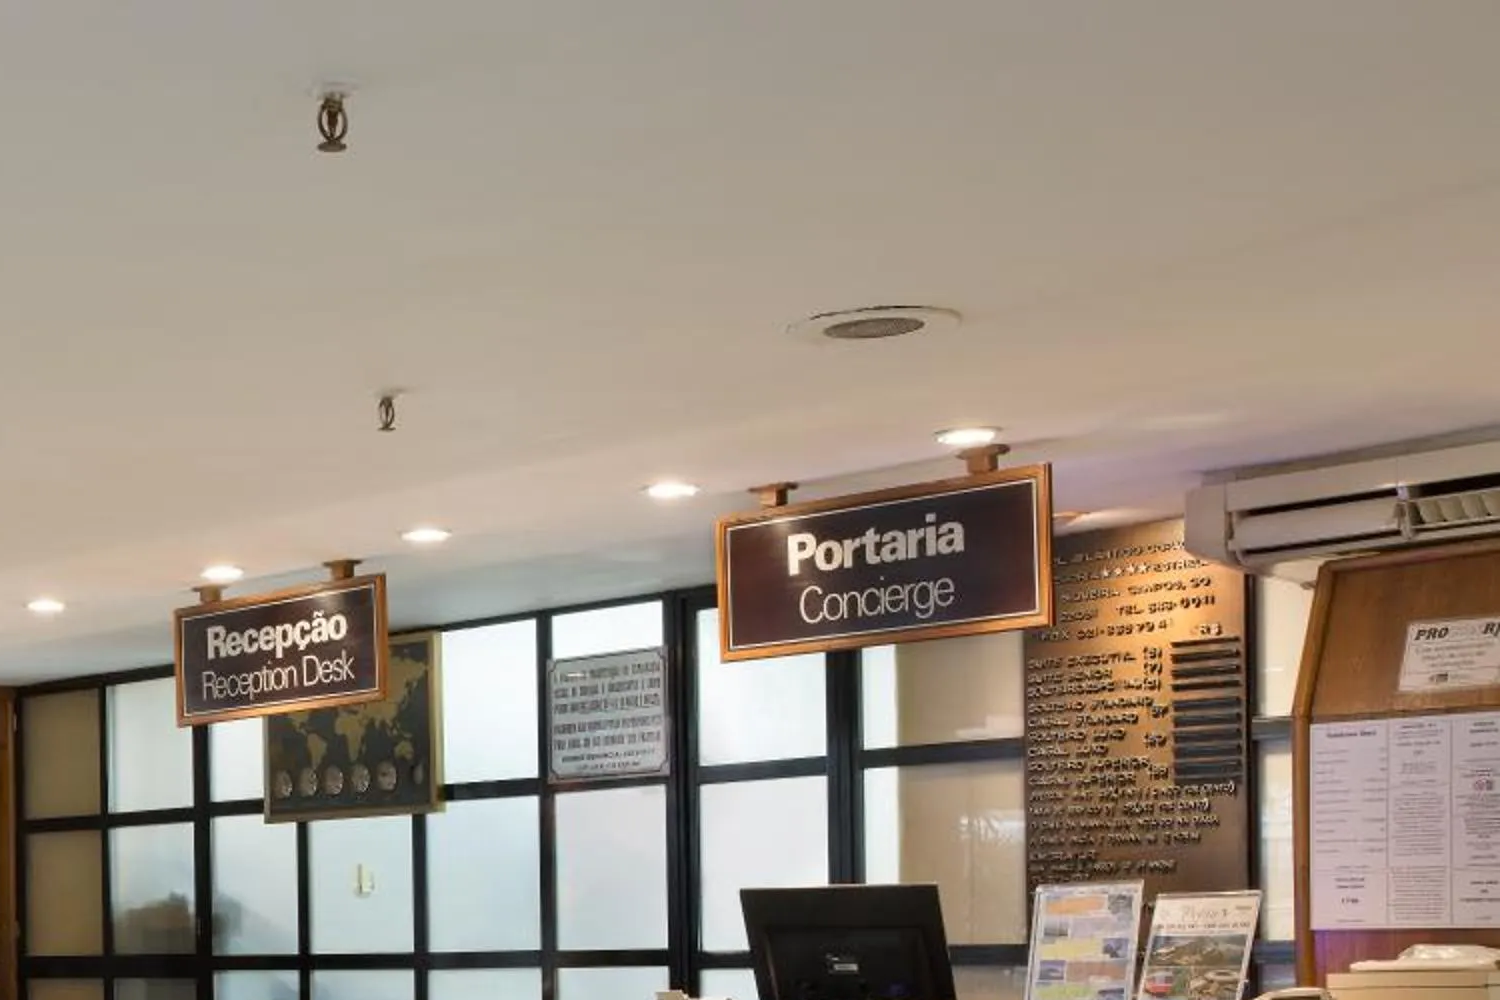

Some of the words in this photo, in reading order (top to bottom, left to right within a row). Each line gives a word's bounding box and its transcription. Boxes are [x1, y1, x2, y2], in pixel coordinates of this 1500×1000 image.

[787, 512, 965, 576] Portaria
[799, 575, 955, 625] Concierge
[206, 611, 349, 660] Recepção
[201, 660, 298, 701] Reception
[302, 650, 356, 688] Desk
